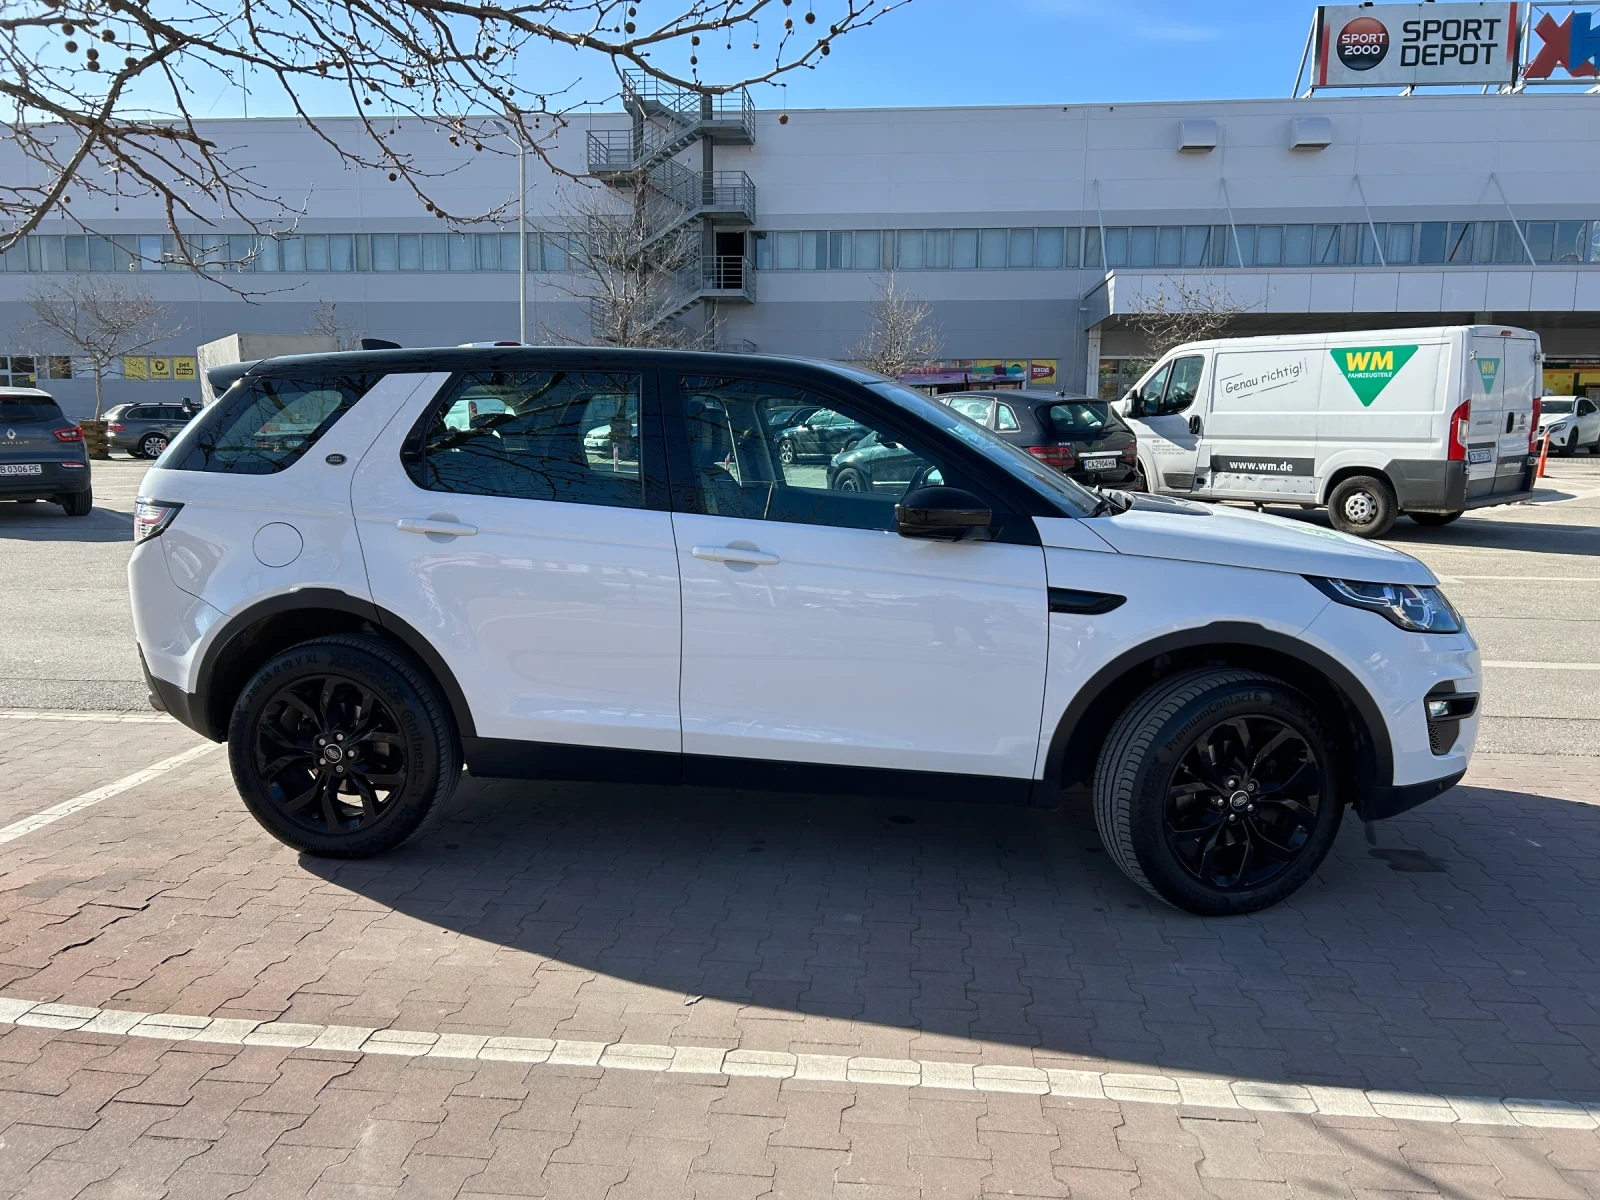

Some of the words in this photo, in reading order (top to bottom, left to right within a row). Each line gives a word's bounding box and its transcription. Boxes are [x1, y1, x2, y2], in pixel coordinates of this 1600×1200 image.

[1341, 33, 1386, 44] SPORT
[1402, 18, 1502, 43] SPORT
[1344, 45, 1381, 55] 2000
[1400, 43, 1498, 67] DEPOT
[1346, 351, 1394, 371] WM
[1481, 361, 1495, 374] WM
[1225, 377, 1258, 394] Genau
[1261, 361, 1303, 379] richtig!
[1347, 371, 1393, 379] FAHRZEUGTEILE
[1229, 461, 1293, 472] www.wm.de
[1165, 692, 1253, 751] PremiumContact
